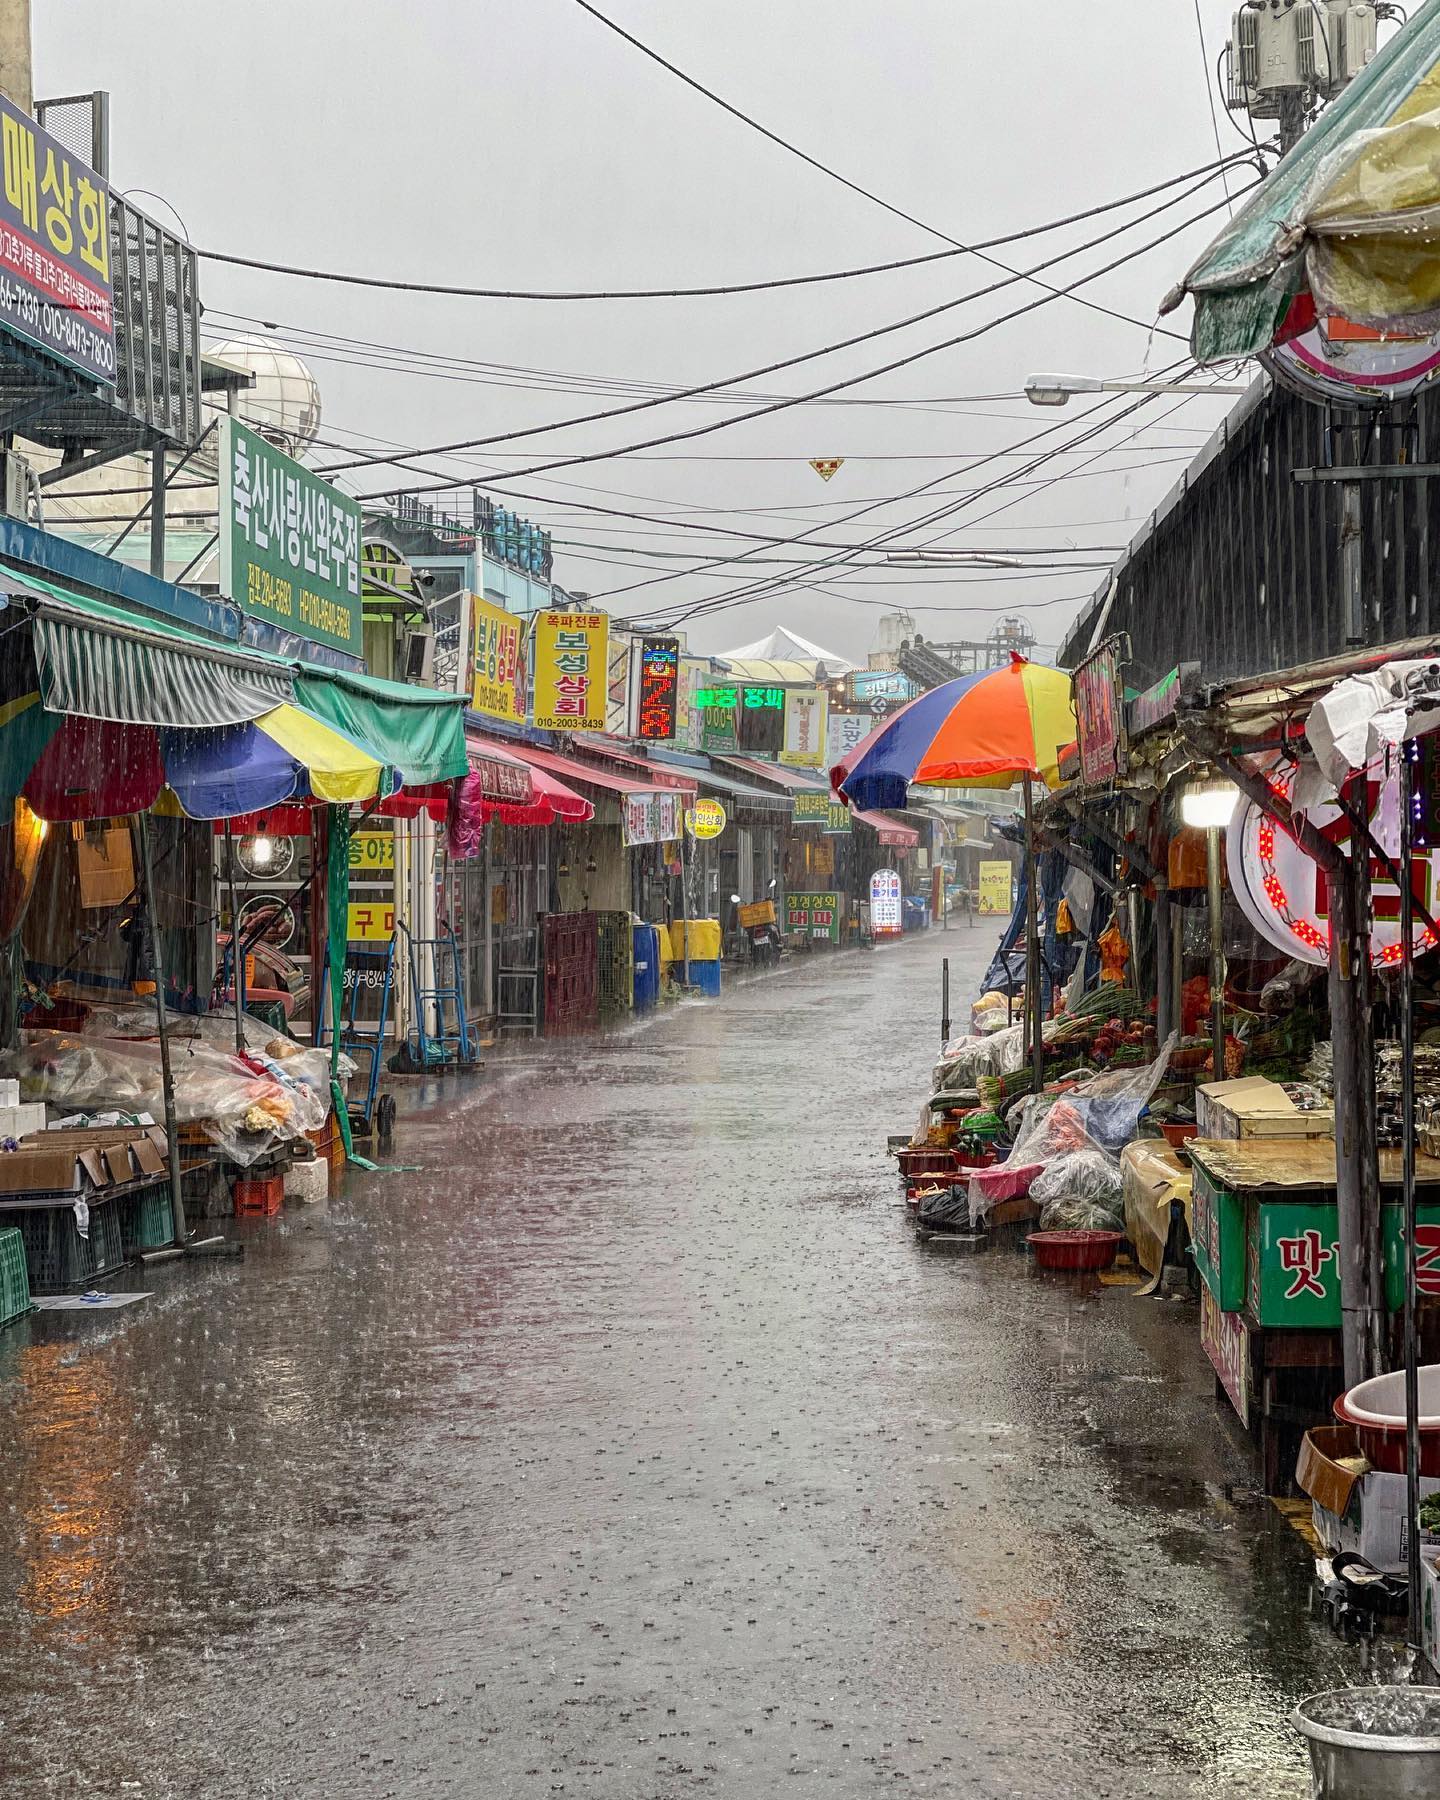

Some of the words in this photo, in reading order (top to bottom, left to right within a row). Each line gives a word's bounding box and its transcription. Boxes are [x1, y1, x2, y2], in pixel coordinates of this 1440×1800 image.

[2, 111, 109, 284] 매상회
[248, 562, 261, 605] 점포
[299, 588, 309, 623] HP
[547, 614, 600, 629] 쪽파전문
[475, 613, 518, 687] 보성상회
[553, 630, 591, 718] 보성상회
[537, 718, 604, 729] 010-2003-8439
[872, 879, 899, 889] 참기름
